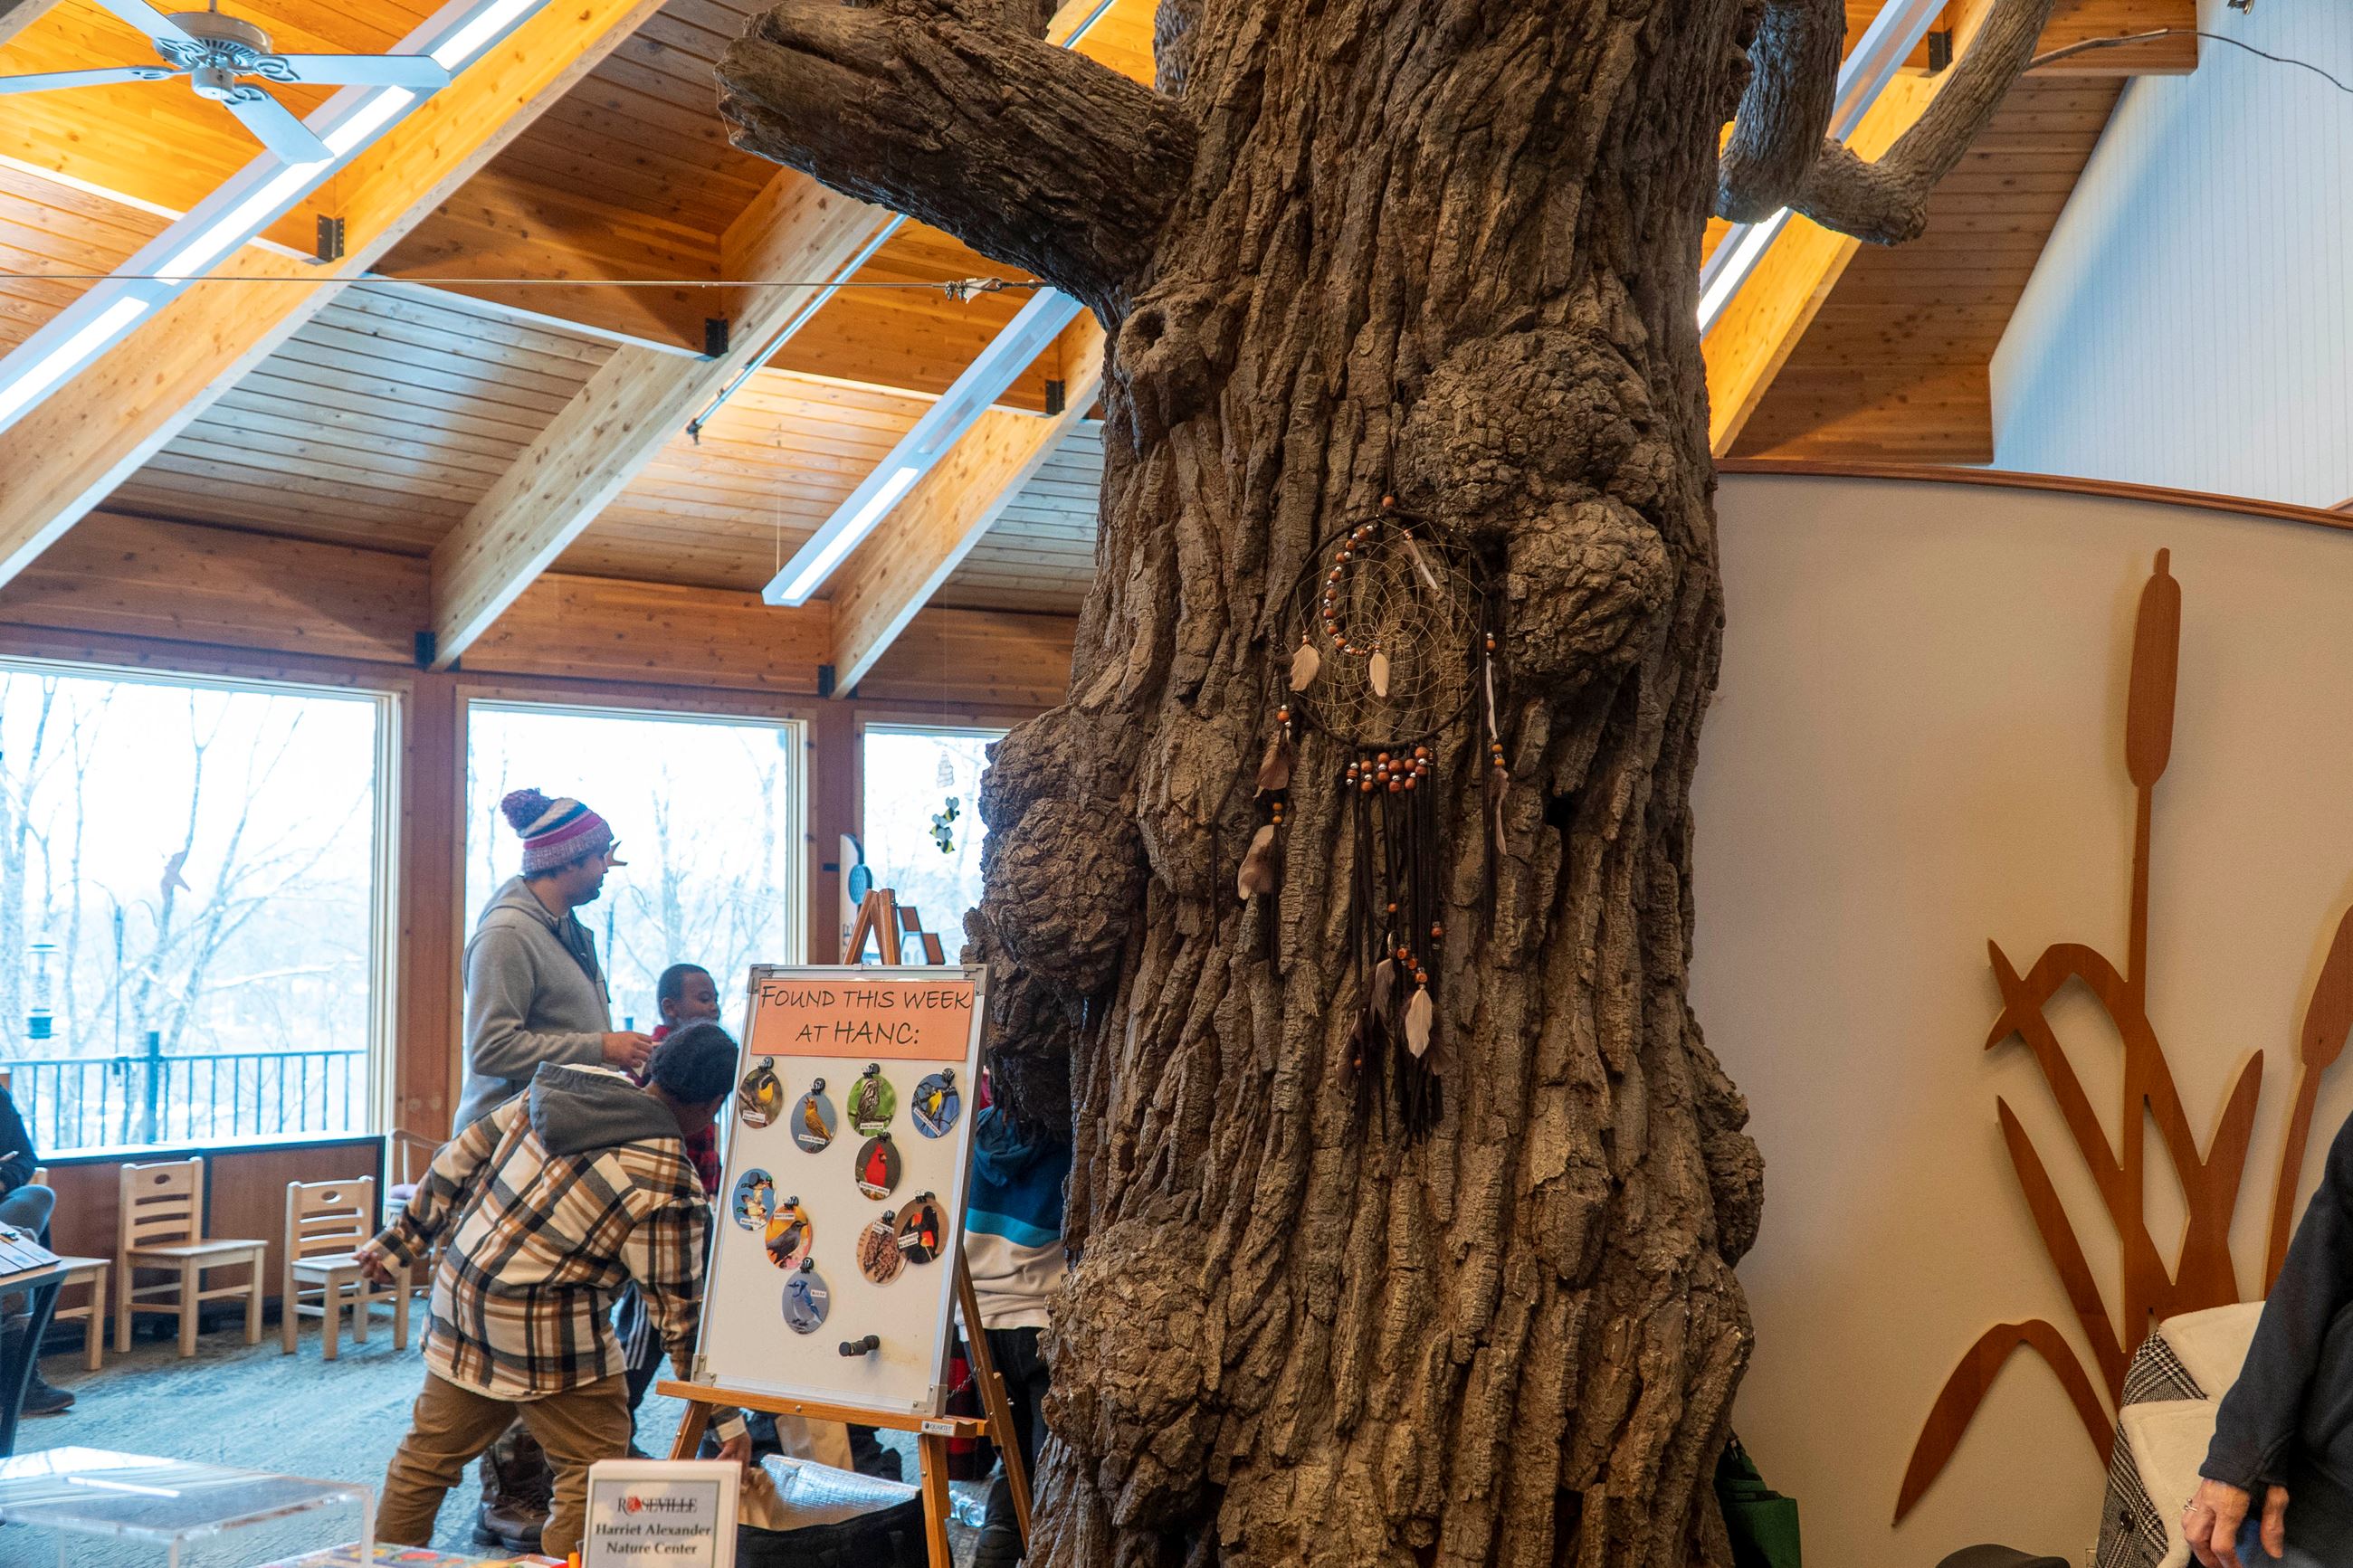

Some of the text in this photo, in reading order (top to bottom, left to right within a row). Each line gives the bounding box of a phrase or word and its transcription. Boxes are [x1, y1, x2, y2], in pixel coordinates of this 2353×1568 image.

[761, 985, 971, 1009] FOUND THIS WEEK
[795, 1021, 919, 1045] AT HANC:
[595, 1524, 711, 1536] Harriet Alexander
[605, 1542, 698, 1555] Nature Center
